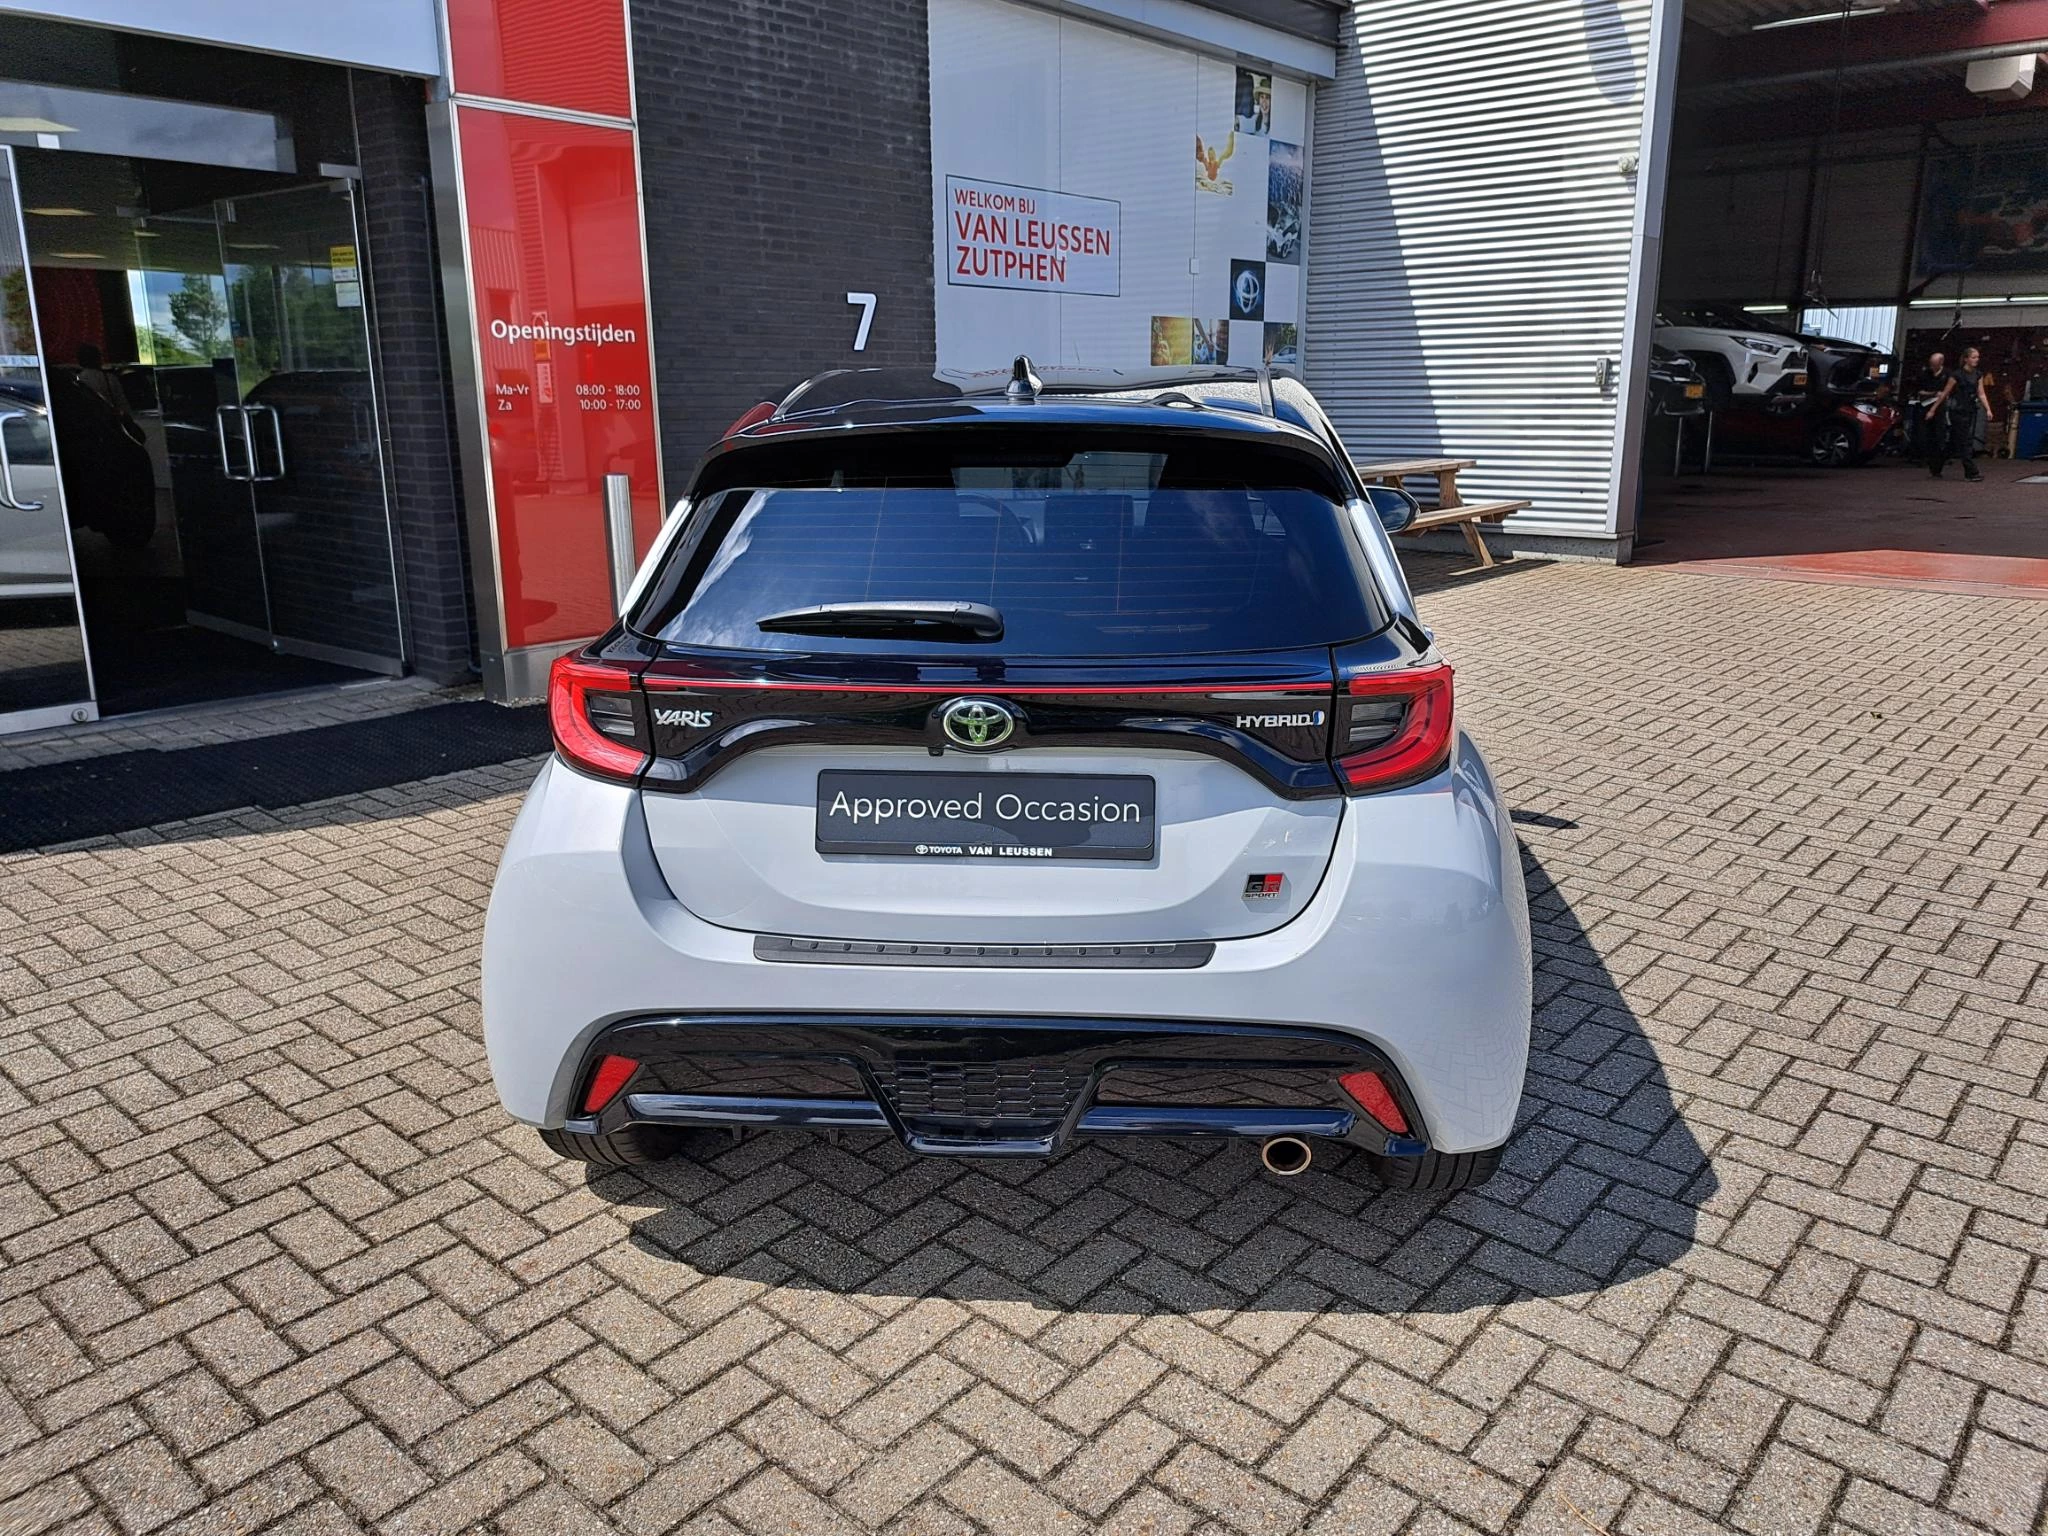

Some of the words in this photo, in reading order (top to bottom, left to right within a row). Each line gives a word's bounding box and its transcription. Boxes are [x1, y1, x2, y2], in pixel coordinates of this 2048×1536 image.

[954, 188, 1015, 213] WELKOM
[1018, 198, 1036, 215] BIJ
[954, 210, 1008, 245] VAN
[1014, 218, 1111, 256] LEUSSEN
[956, 245, 1066, 283] ZUTPHEN
[490, 318, 637, 347] Openingstijden
[846, 291, 877, 351] 7
[495, 383, 530, 396] Ma-Vr
[575, 384, 606, 396] 08:00
[613, 384, 641, 396] 18:00
[498, 399, 513, 411] Za
[580, 399, 607, 410] 10:00
[615, 399, 642, 410] 17:00
[653, 708, 714, 728] YARIS
[1236, 714, 1312, 728] HYBRID
[828, 790, 983, 825] Approved
[995, 793, 1141, 823] Occasion
[928, 846, 963, 856] TOYOTA
[968, 846, 993, 856] VAN
[998, 846, 1053, 858] LEUSSEN
[1246, 881, 1280, 893] GR
